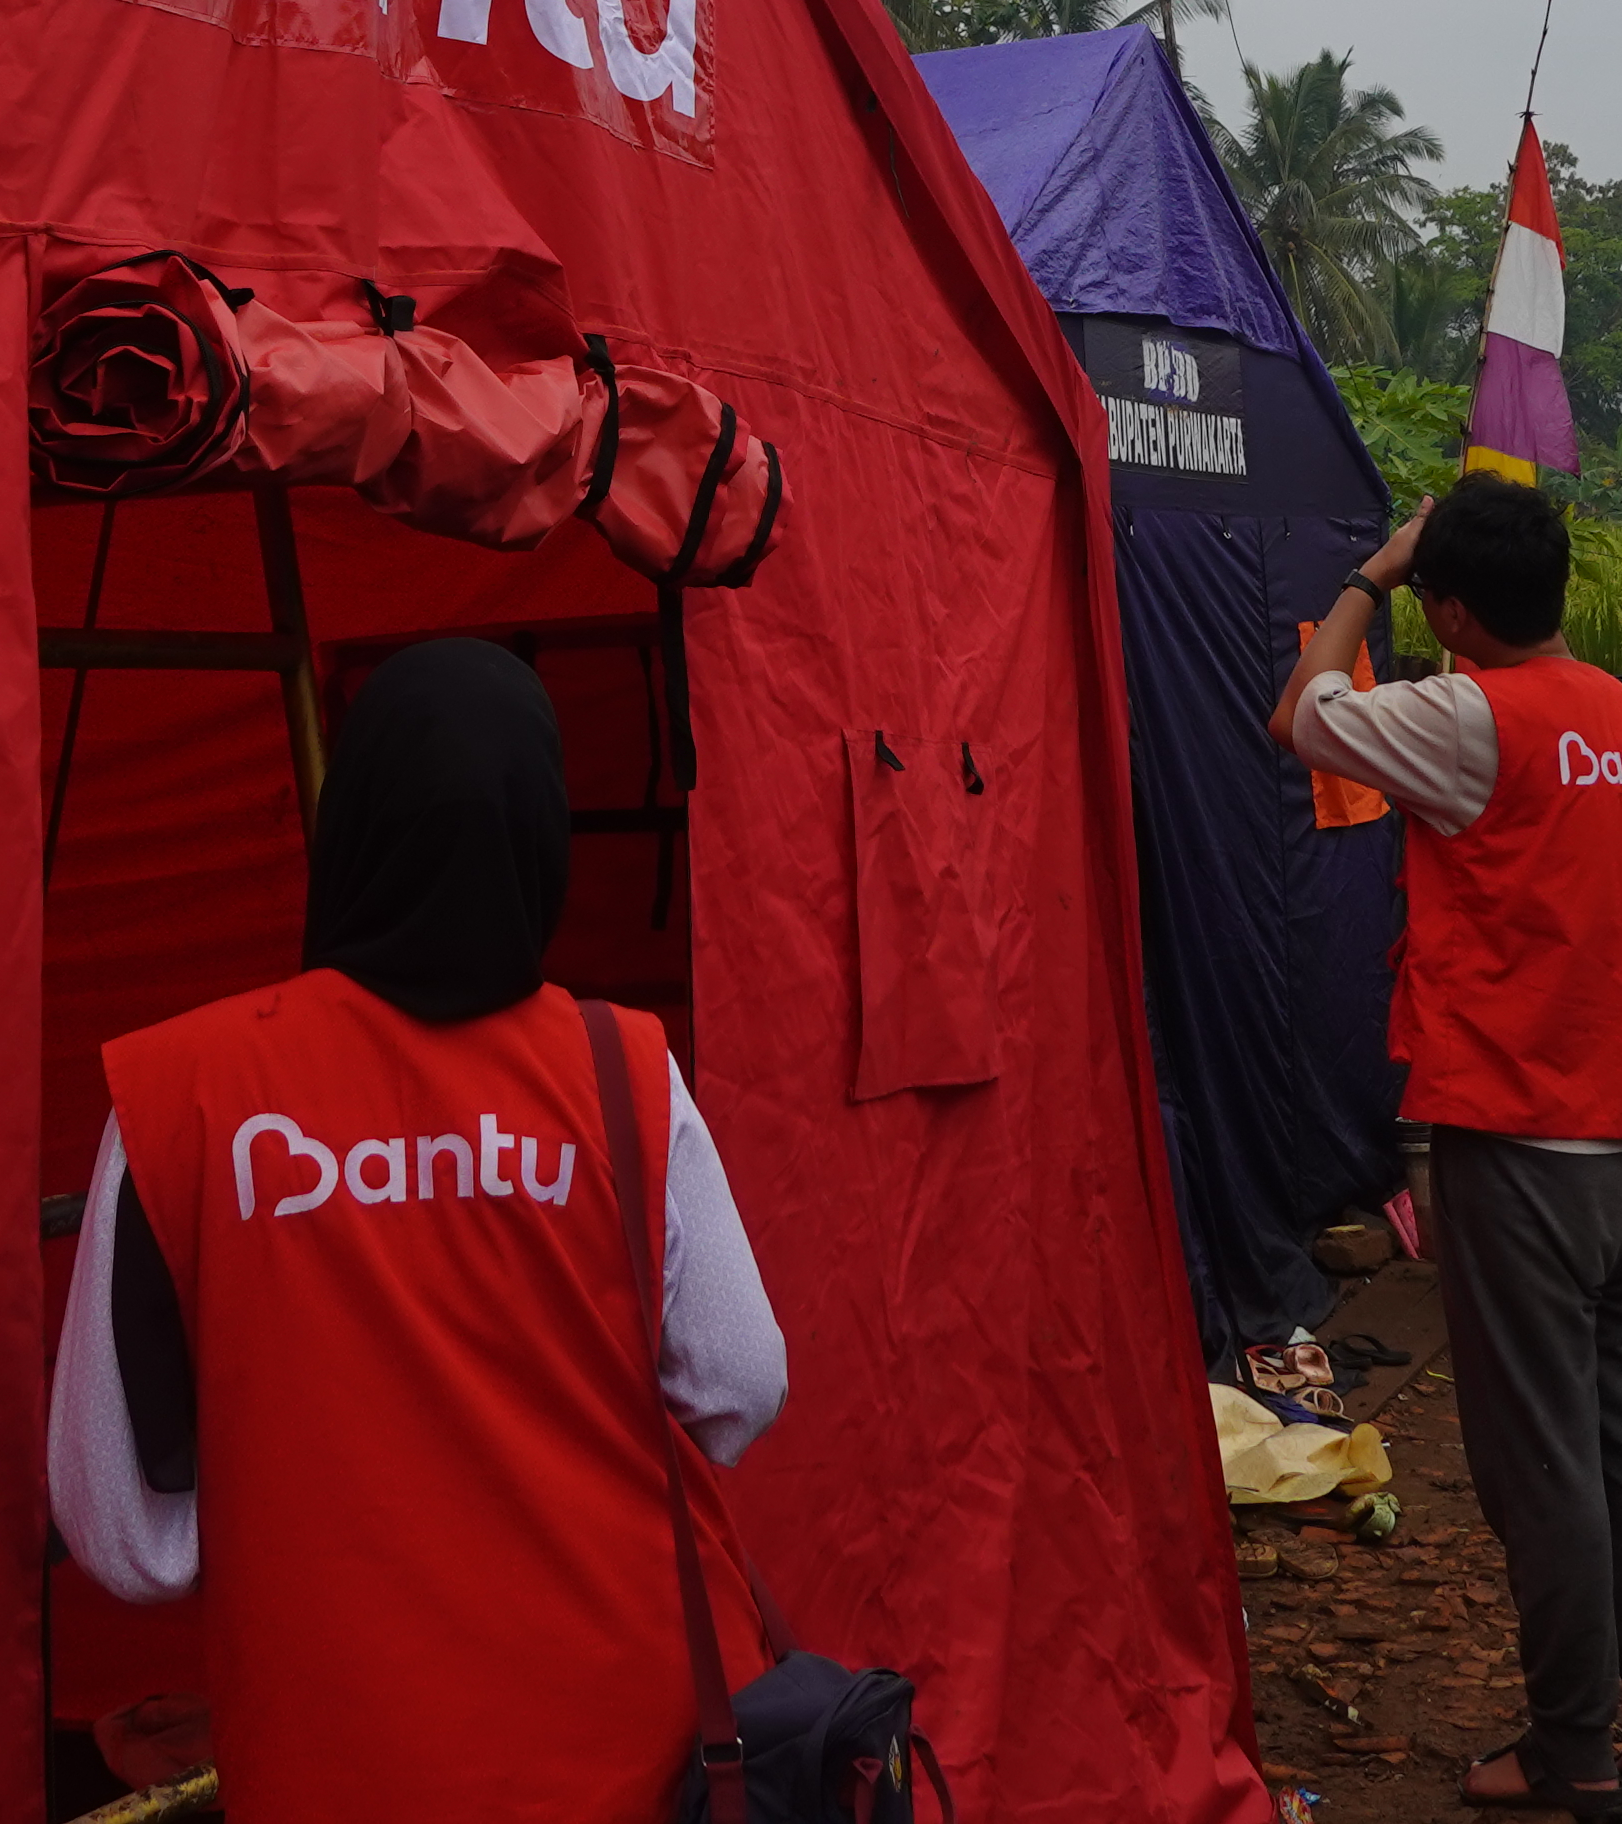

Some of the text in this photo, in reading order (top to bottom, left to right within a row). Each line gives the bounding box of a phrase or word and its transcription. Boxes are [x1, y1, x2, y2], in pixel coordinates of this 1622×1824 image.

[1097, 394, 1247, 477] BUPATEN PURWAKARTA
[232, 1112, 577, 1221] Bantu
